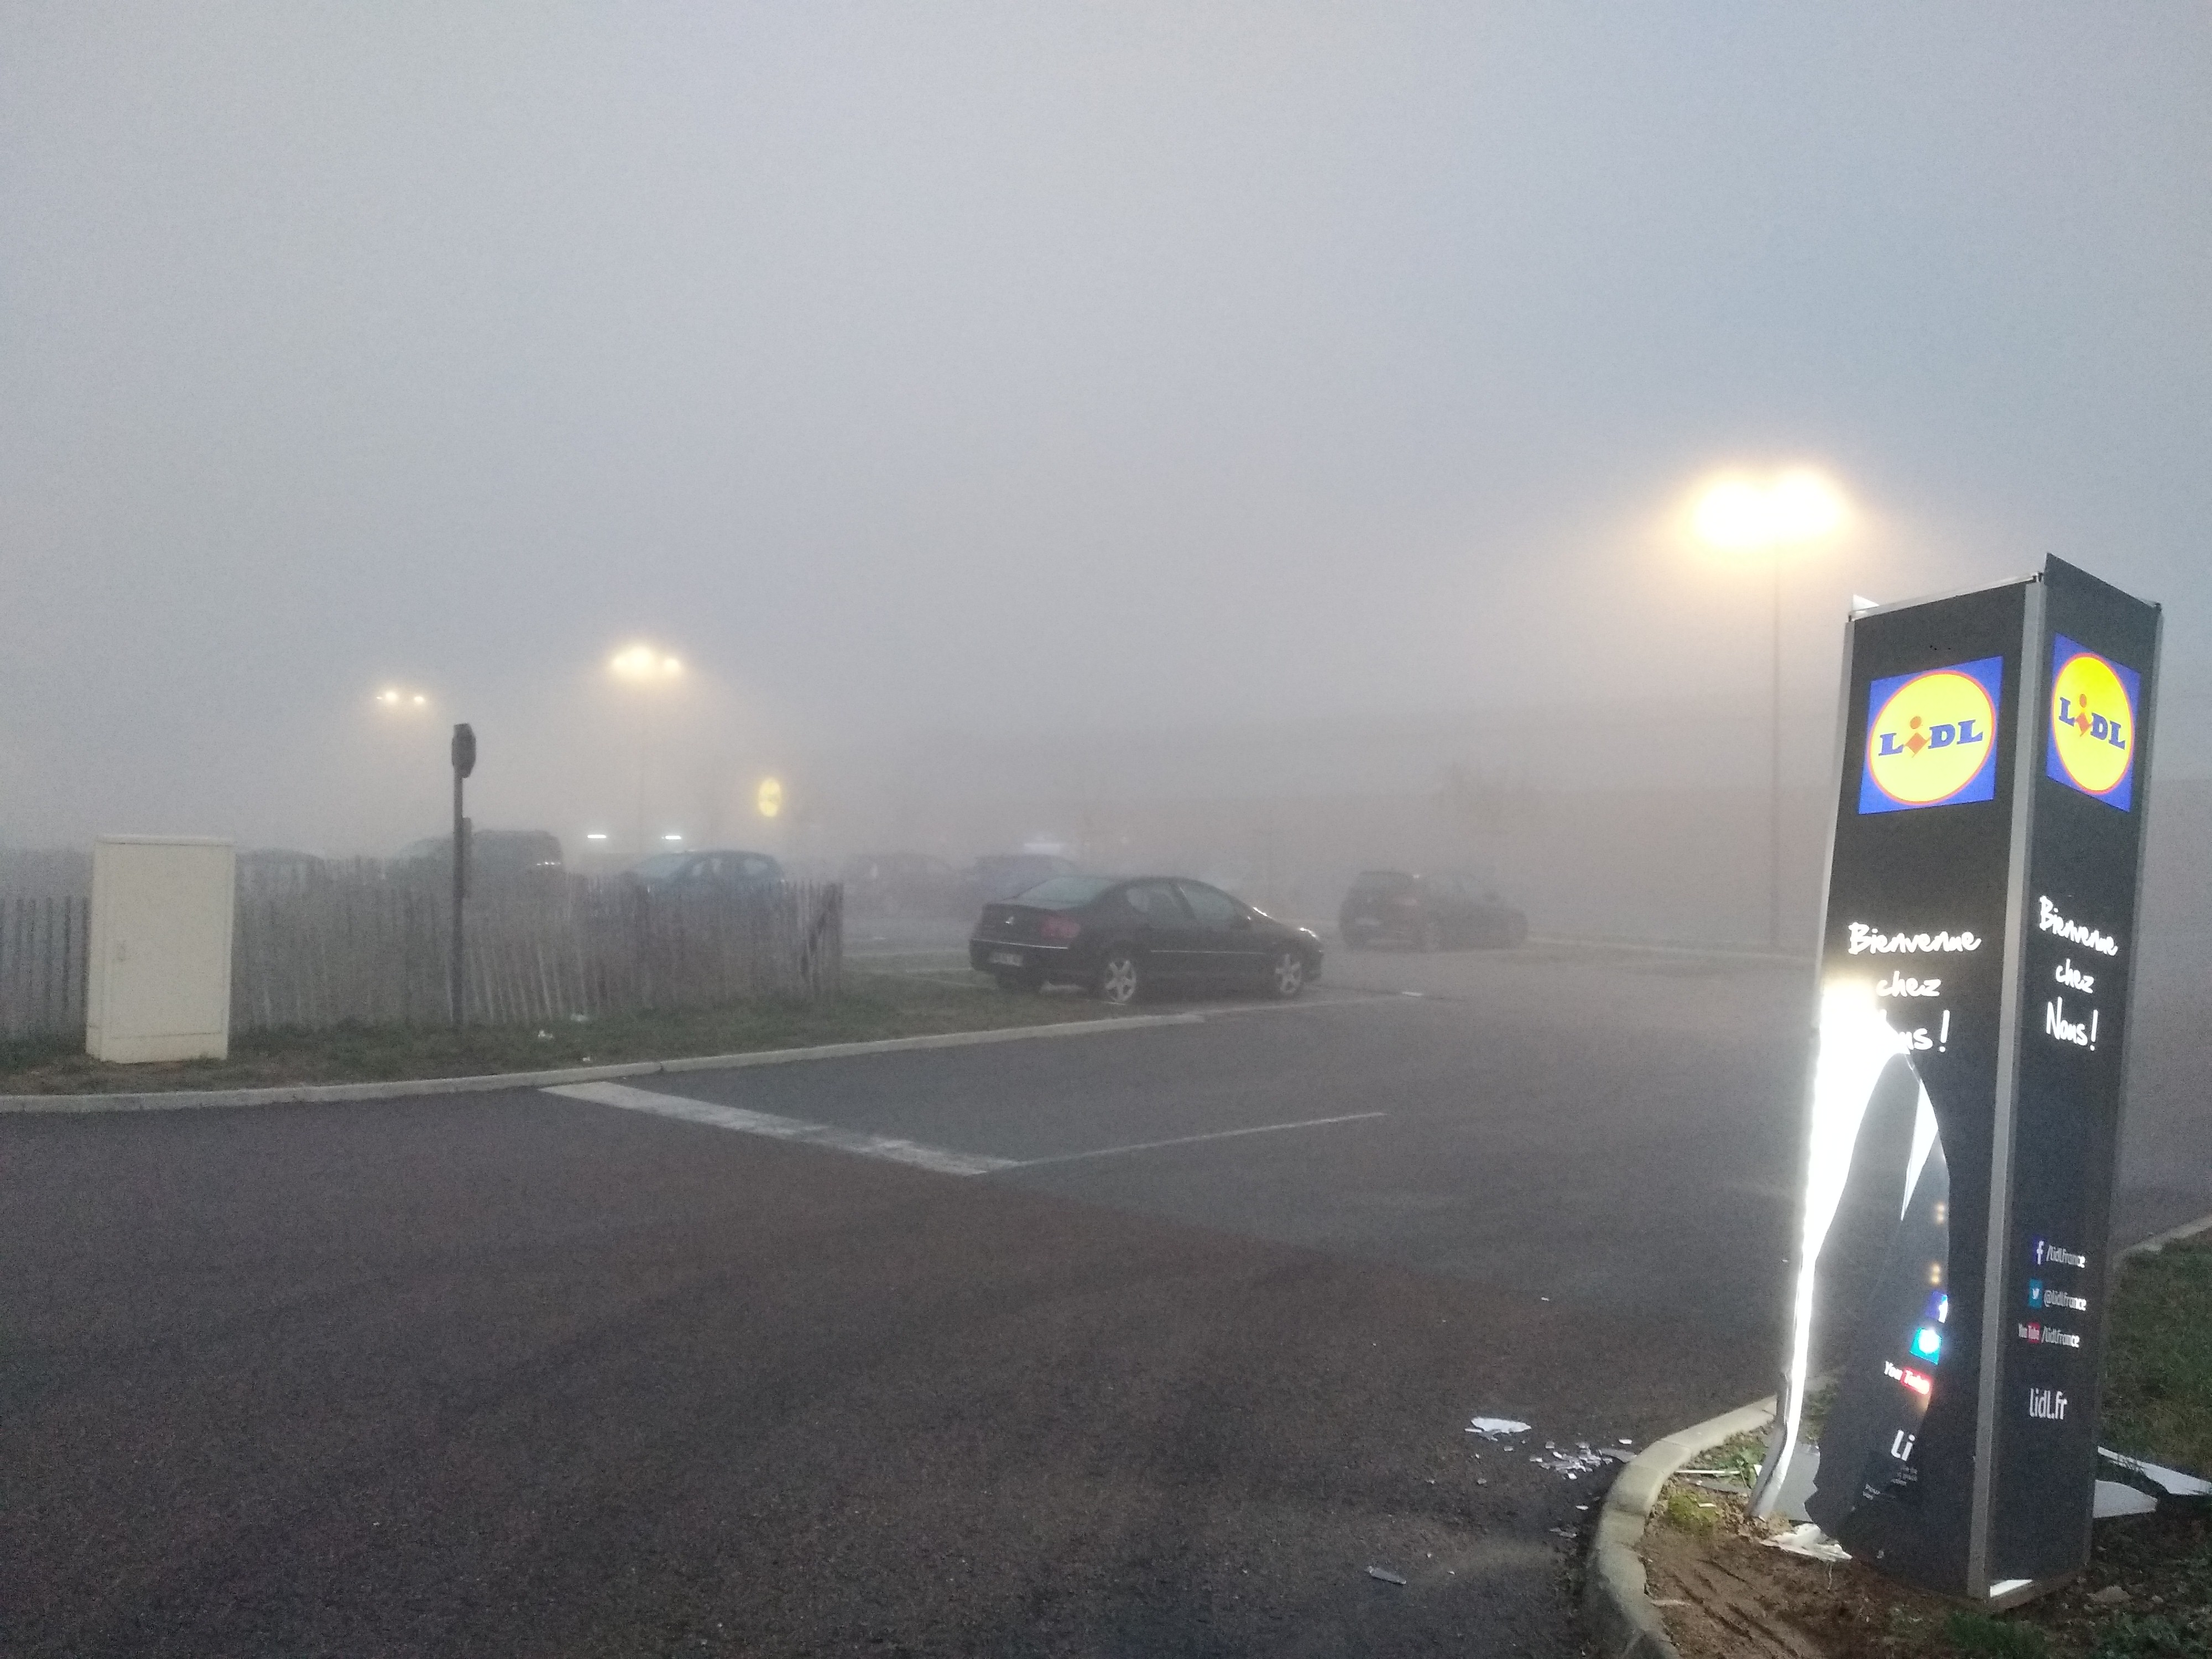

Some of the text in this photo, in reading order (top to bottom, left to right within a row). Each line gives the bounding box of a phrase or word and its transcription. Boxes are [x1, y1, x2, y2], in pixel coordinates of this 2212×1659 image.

[1848, 922, 1982, 955] Bienvenue
[2039, 895, 2119, 956] Bienvenue
[1876, 971, 1942, 997] chez
[2056, 958, 2094, 994] chez
